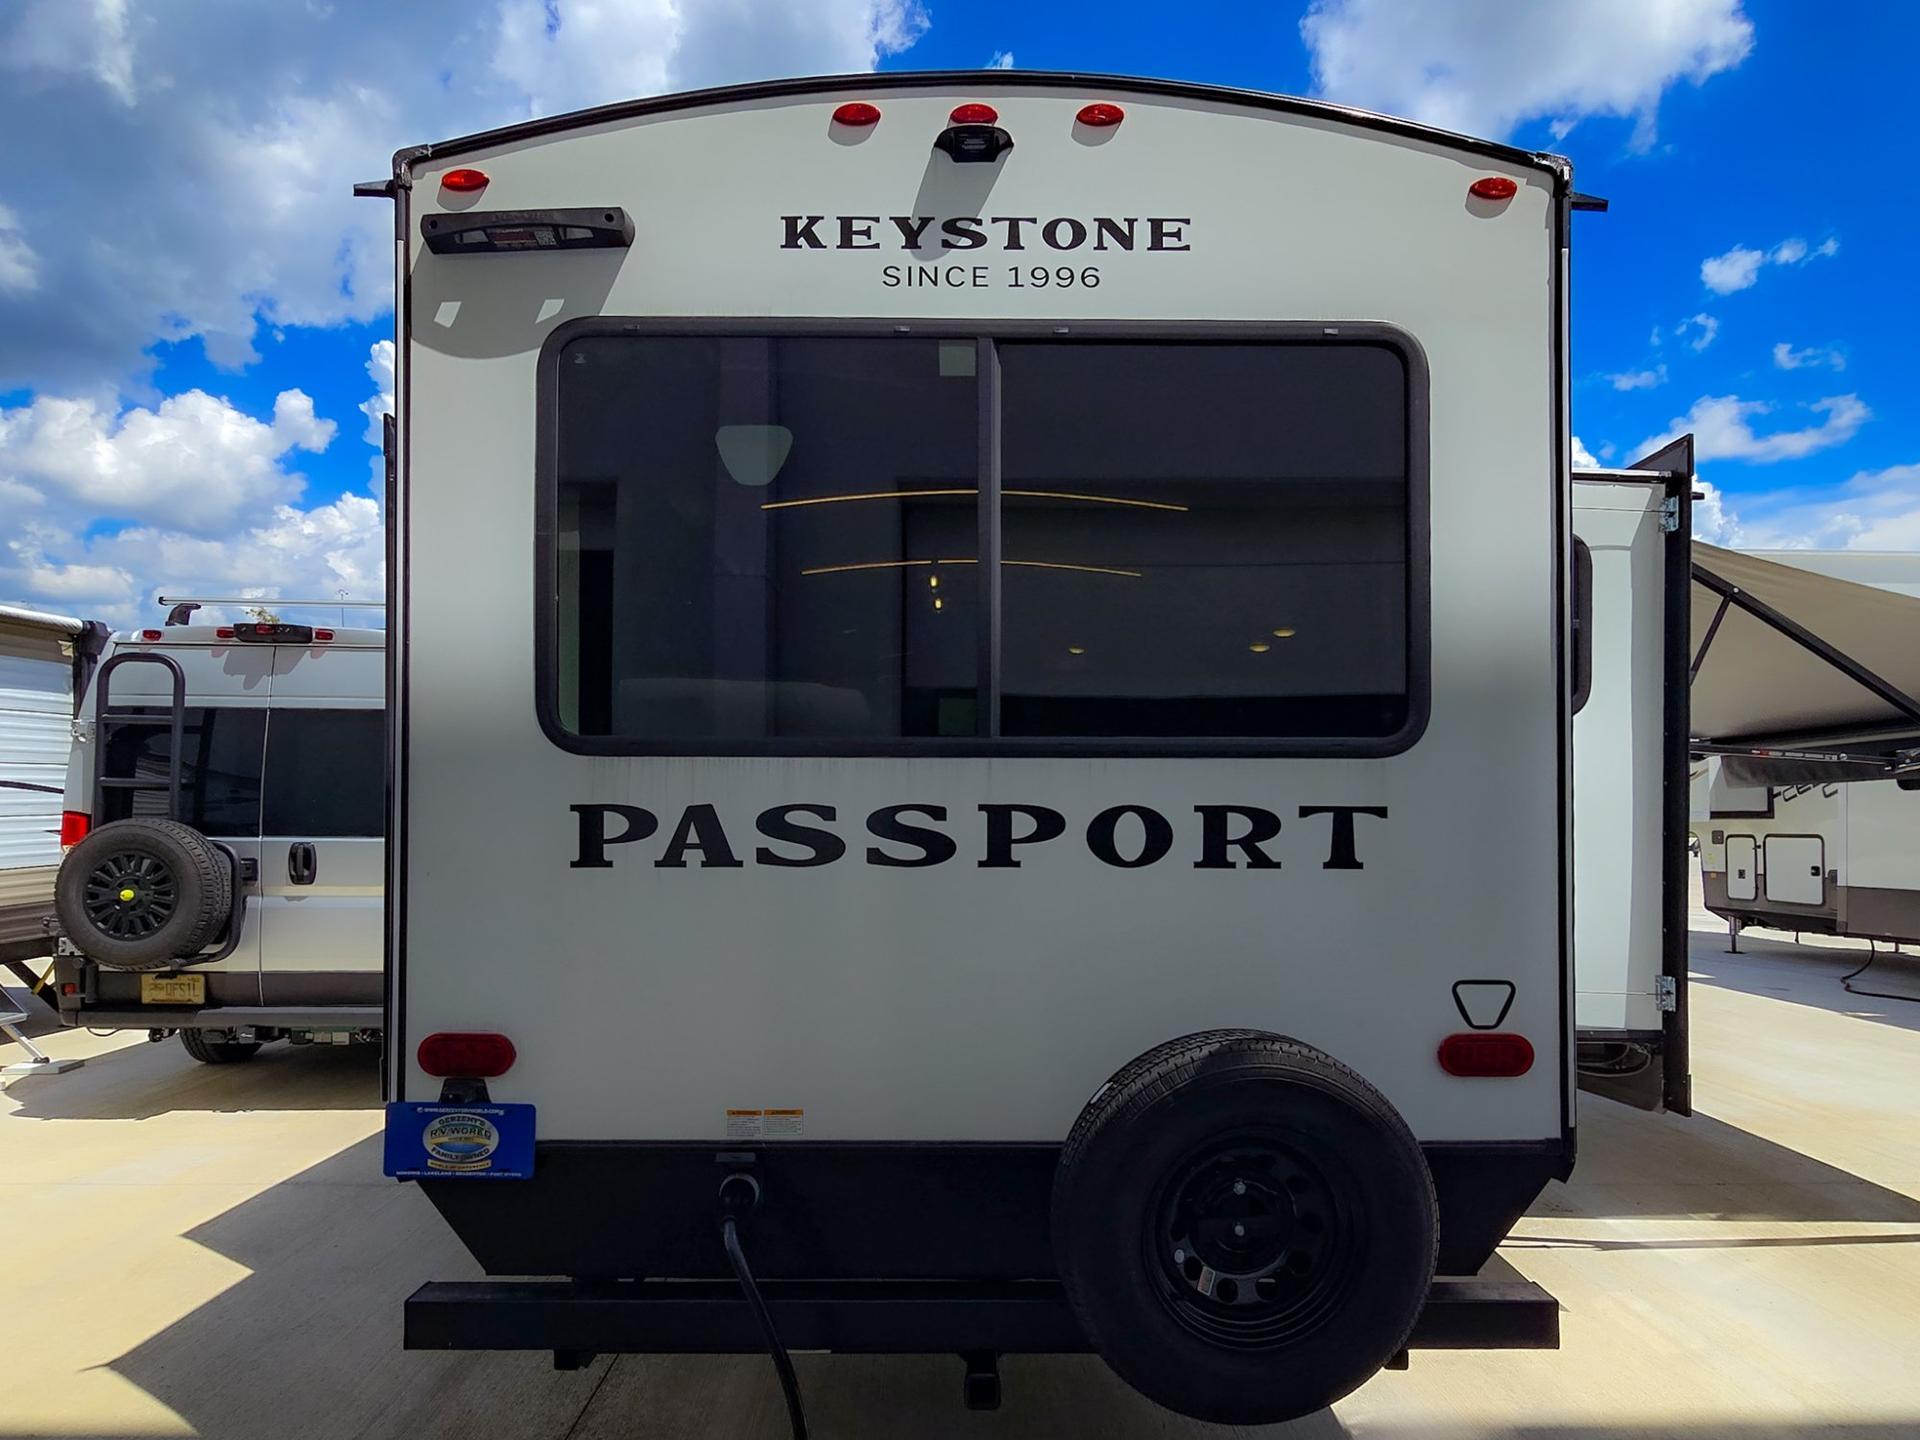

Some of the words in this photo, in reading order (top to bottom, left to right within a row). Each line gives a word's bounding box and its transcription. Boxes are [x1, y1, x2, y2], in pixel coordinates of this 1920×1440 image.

[781, 215, 1191, 251] KEYSTONE
[882, 265, 989, 288] SINCE
[1008, 266, 1100, 289] 1996
[570, 803, 1389, 870] PASSPORT
